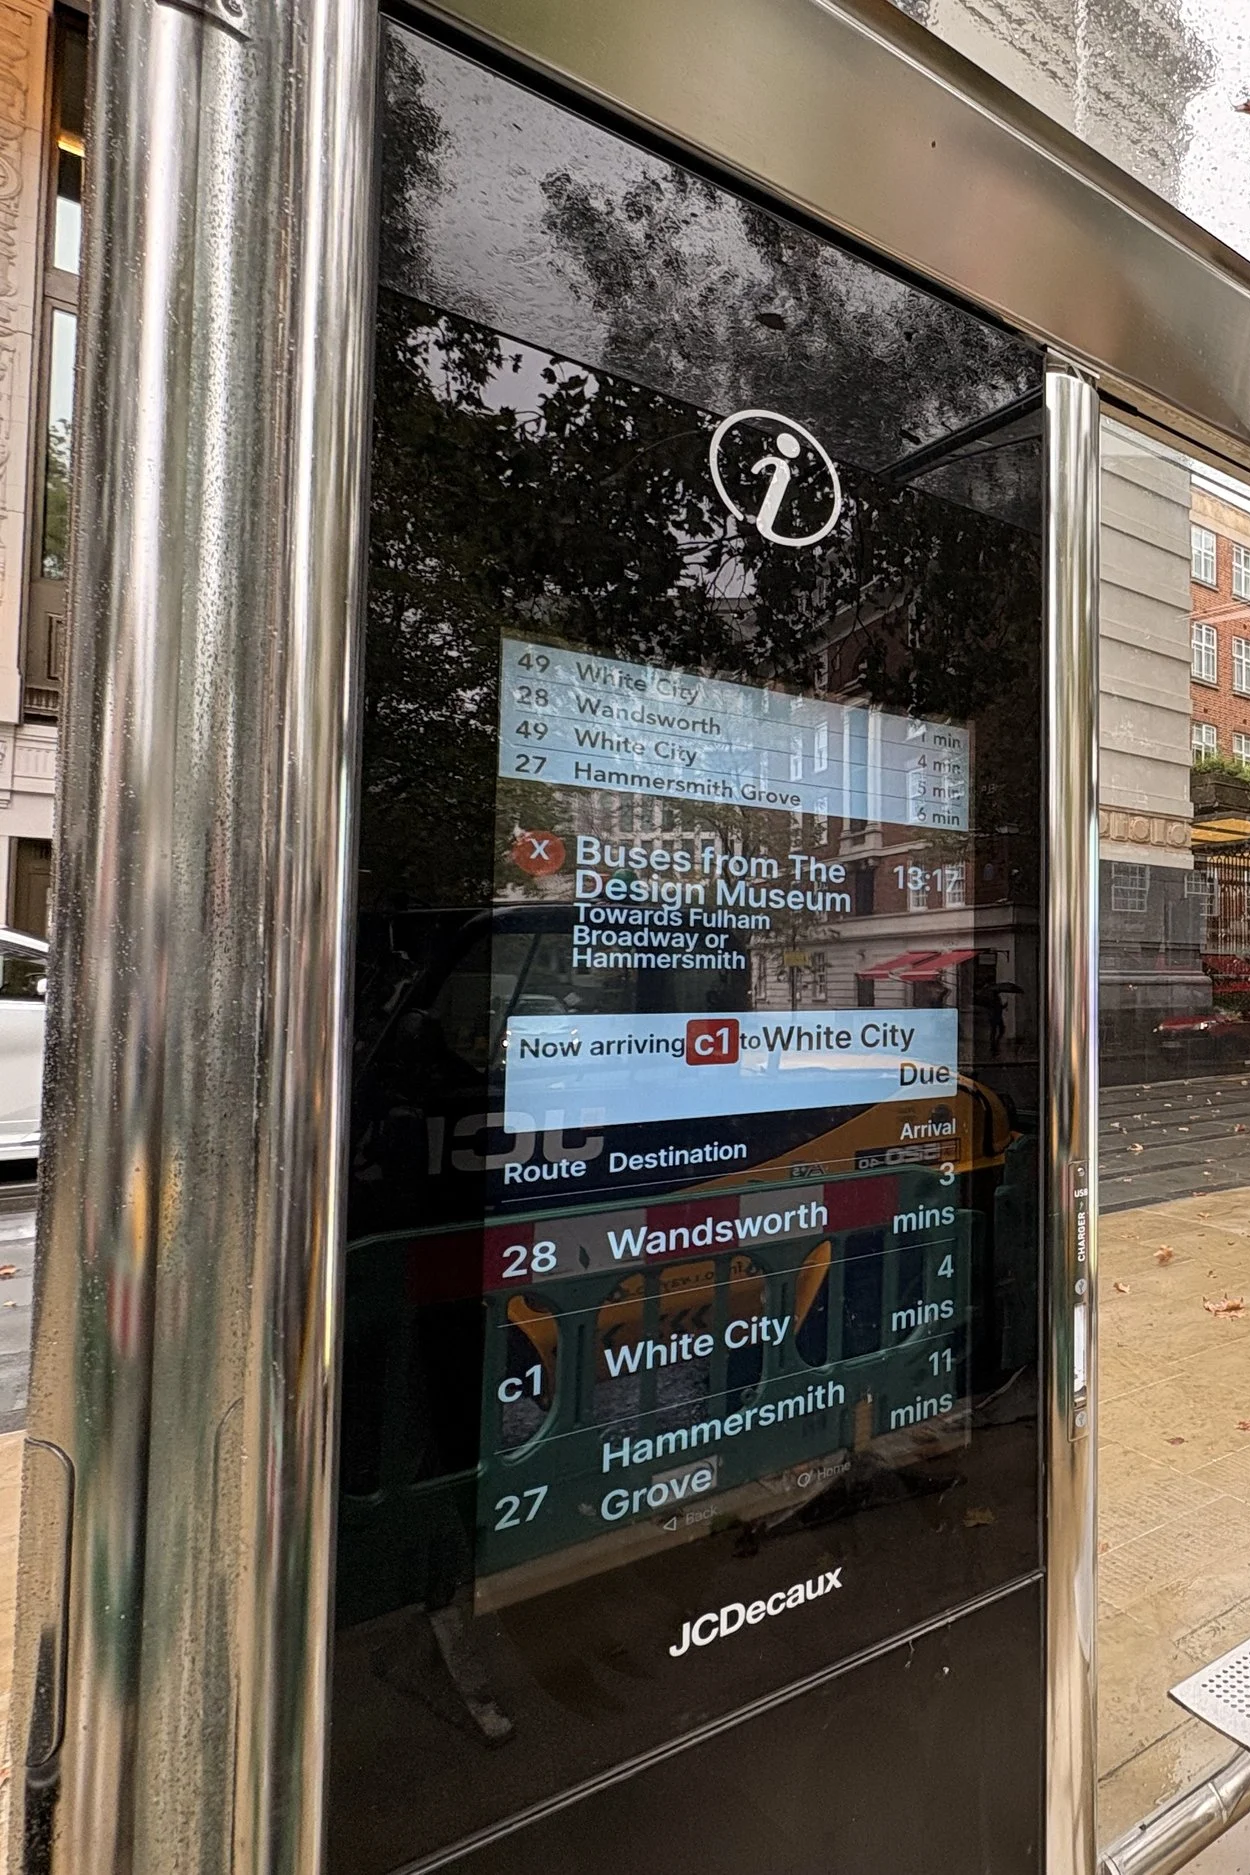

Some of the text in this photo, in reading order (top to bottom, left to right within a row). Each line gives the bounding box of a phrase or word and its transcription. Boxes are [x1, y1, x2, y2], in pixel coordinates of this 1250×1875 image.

[517, 653, 550, 673] 49
[576, 662, 648, 691] White
[656, 678, 700, 705] City
[933, 733, 961, 748] min
[516, 685, 961, 774] 28 Wandsworth 4 min
[515, 720, 961, 800] 49 White City 5 min
[515, 754, 960, 825] 27 Hammersmith Grove 6 min
[576, 835, 846, 884] Buses from The
[893, 865, 960, 892] 13:17
[575, 869, 851, 912] Design Museum
[574, 902, 771, 930] Towards Fulham
[573, 925, 729, 952] Broadway or
[572, 948, 746, 970] Hammersmith
[519, 1023, 915, 1060] Now arriving c1 to White City
[899, 1063, 950, 1087] Due
[504, 1118, 957, 1185] Route Destination Arrival
[1074, 1188, 1088, 1198] USB
[501, 1162, 955, 1279] 28 Wandsworth 3
[892, 1206, 956, 1235] mins
[1077, 1212, 1086, 1262] CHARGER
[938, 1256, 955, 1280] 4
[891, 1299, 955, 1332] mins
[496, 1314, 791, 1403] c1 White City
[929, 1348, 954, 1376] 11
[889, 1392, 954, 1430] mins
[494, 1381, 846, 1531] 27 Hammersmith
[817, 1461, 851, 1480] Home
[600, 1465, 713, 1521] Grove
[686, 1504, 718, 1525] Back
[669, 1566, 843, 1658] JCDecaux
